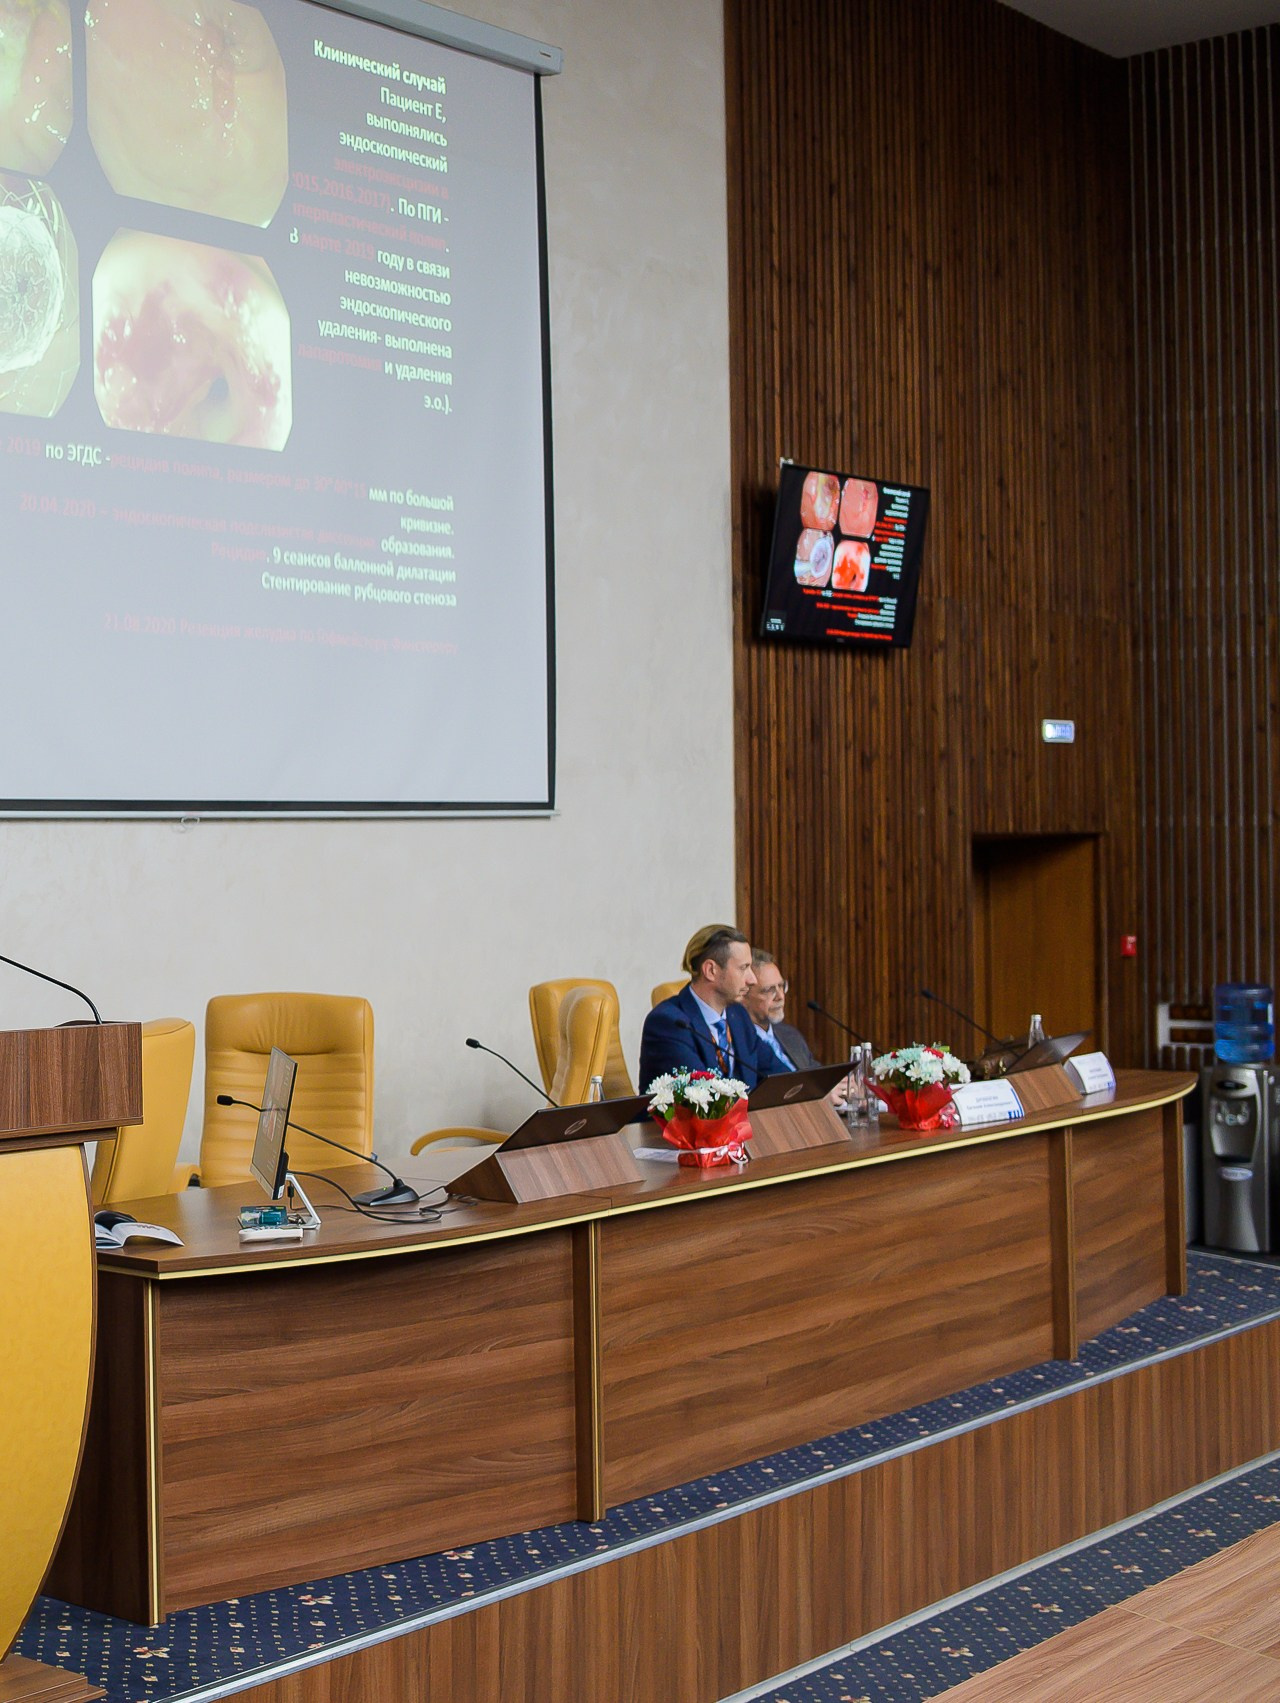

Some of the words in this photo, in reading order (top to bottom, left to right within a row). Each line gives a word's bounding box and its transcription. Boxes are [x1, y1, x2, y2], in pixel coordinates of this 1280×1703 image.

[314, 39, 400, 80] Клинический
[403, 70, 446, 94] случай
[380, 86, 433, 117] Пациент
[366, 112, 447, 146] выполнялись
[339, 132, 448, 173] эндоскопический
[398, 198, 416, 217] По
[418, 202, 442, 224] ПГИ
[378, 250, 404, 271] году
[406, 258, 414, 270] в
[416, 260, 450, 279] связи
[345, 270, 451, 306] невозможностью
[340, 296, 452, 332] эндоскопического
[385, 334, 452, 359] выполнена
[384, 362, 392, 374] и
[395, 362, 452, 386] удаления
[46, 444, 63, 460] по
[67, 444, 102, 467] ЭГДС
[369, 488, 388, 502] мм
[390, 492, 404, 504] по
[406, 489, 454, 511] большой
[400, 516, 454, 536] кривизне.
[381, 536, 454, 559] образования.
[272, 546, 282, 564] 9
[284, 550, 330, 570] сеансов
[334, 552, 394, 577] баллонной
[396, 564, 456, 584] дилатации
[262, 572, 350, 597] Стентирование
[354, 582, 411, 604] рубцового
[414, 592, 456, 606] стеноза
